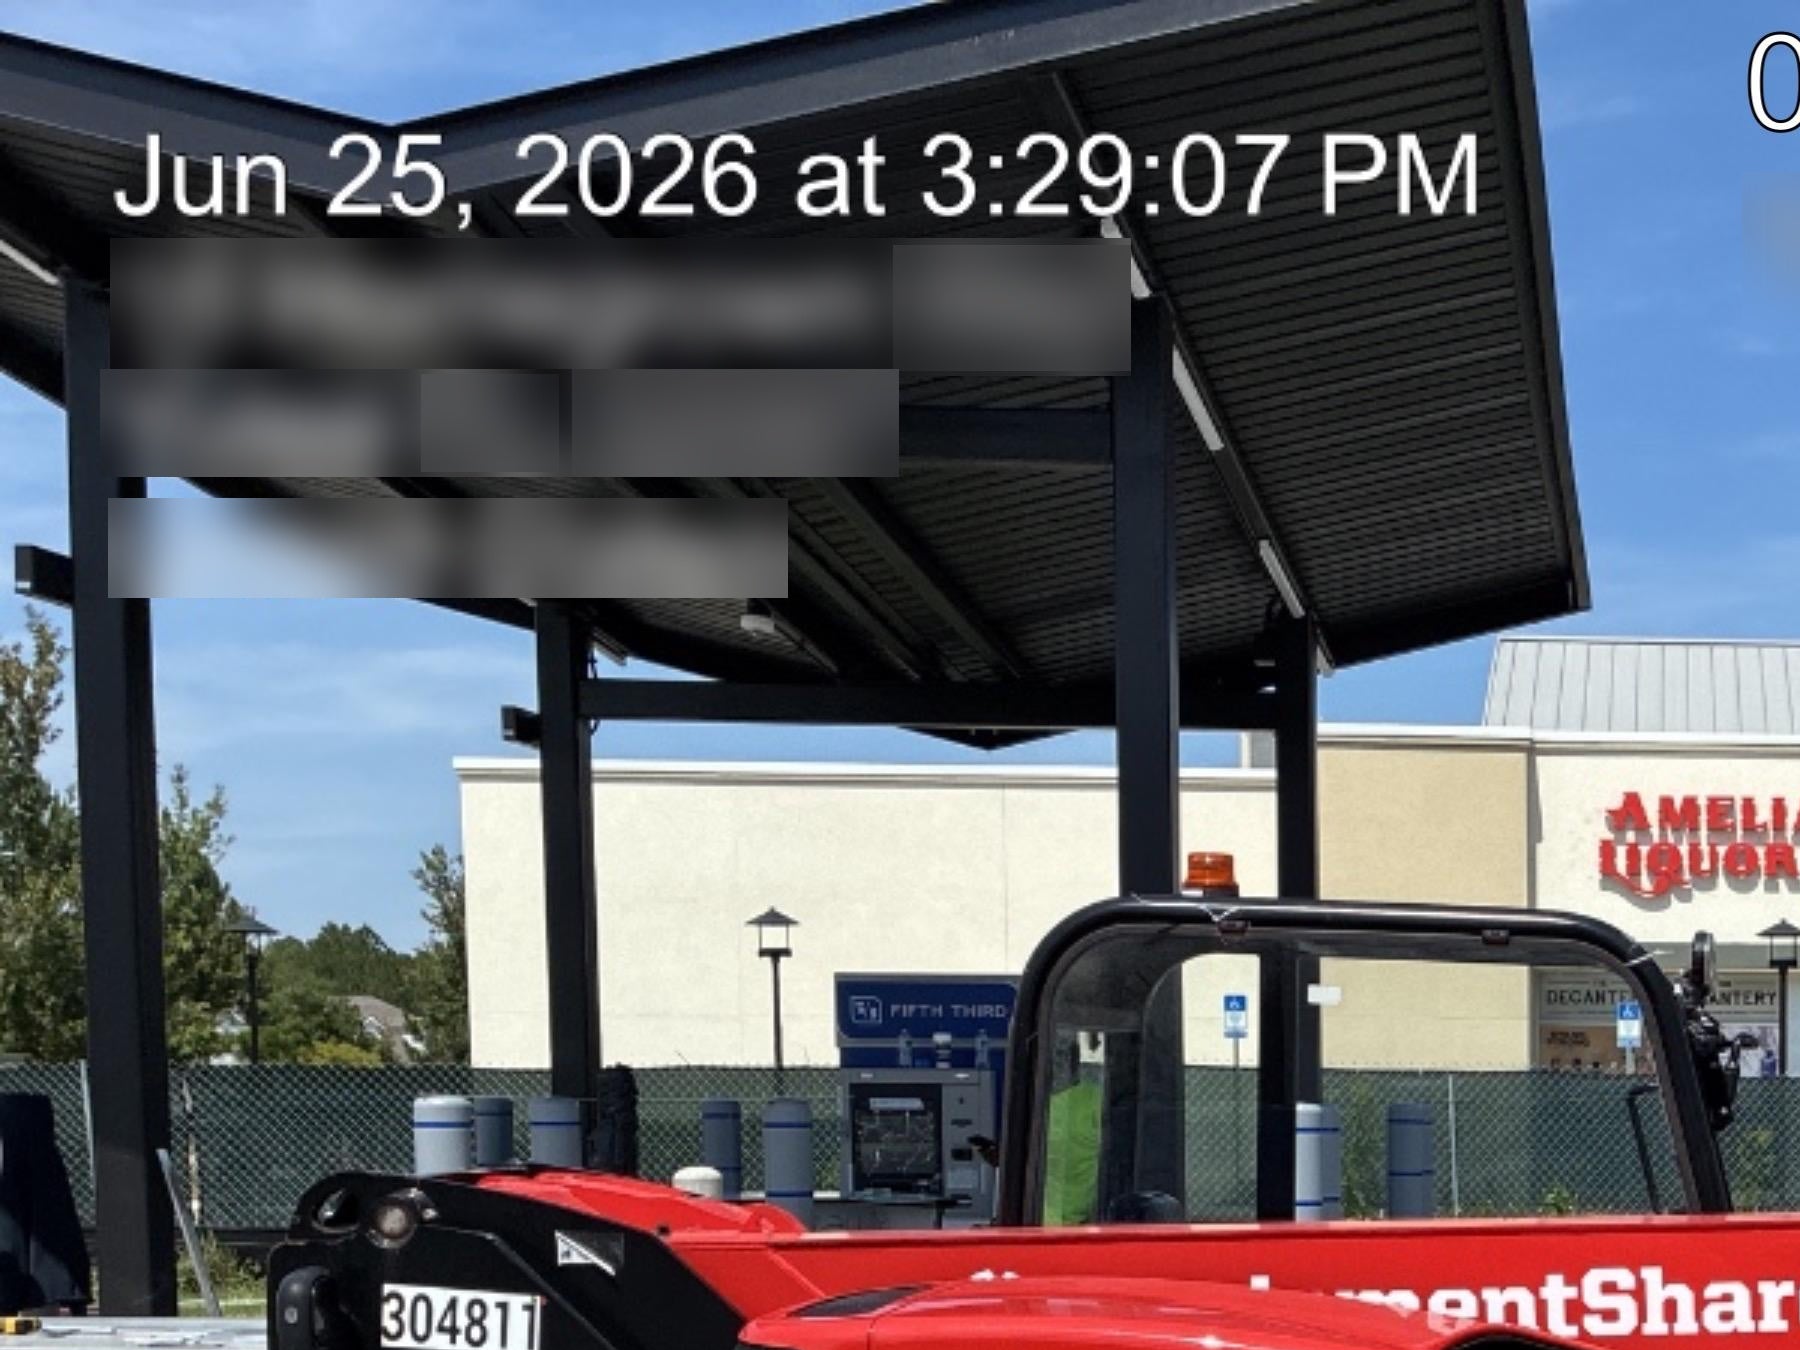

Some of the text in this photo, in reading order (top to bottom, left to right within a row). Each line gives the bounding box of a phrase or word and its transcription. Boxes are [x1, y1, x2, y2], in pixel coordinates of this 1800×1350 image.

[1547, 989, 1629, 1005] DECANTE
[890, 1004, 943, 1018] FIFTH
[950, 1004, 1007, 1018] THIRD
